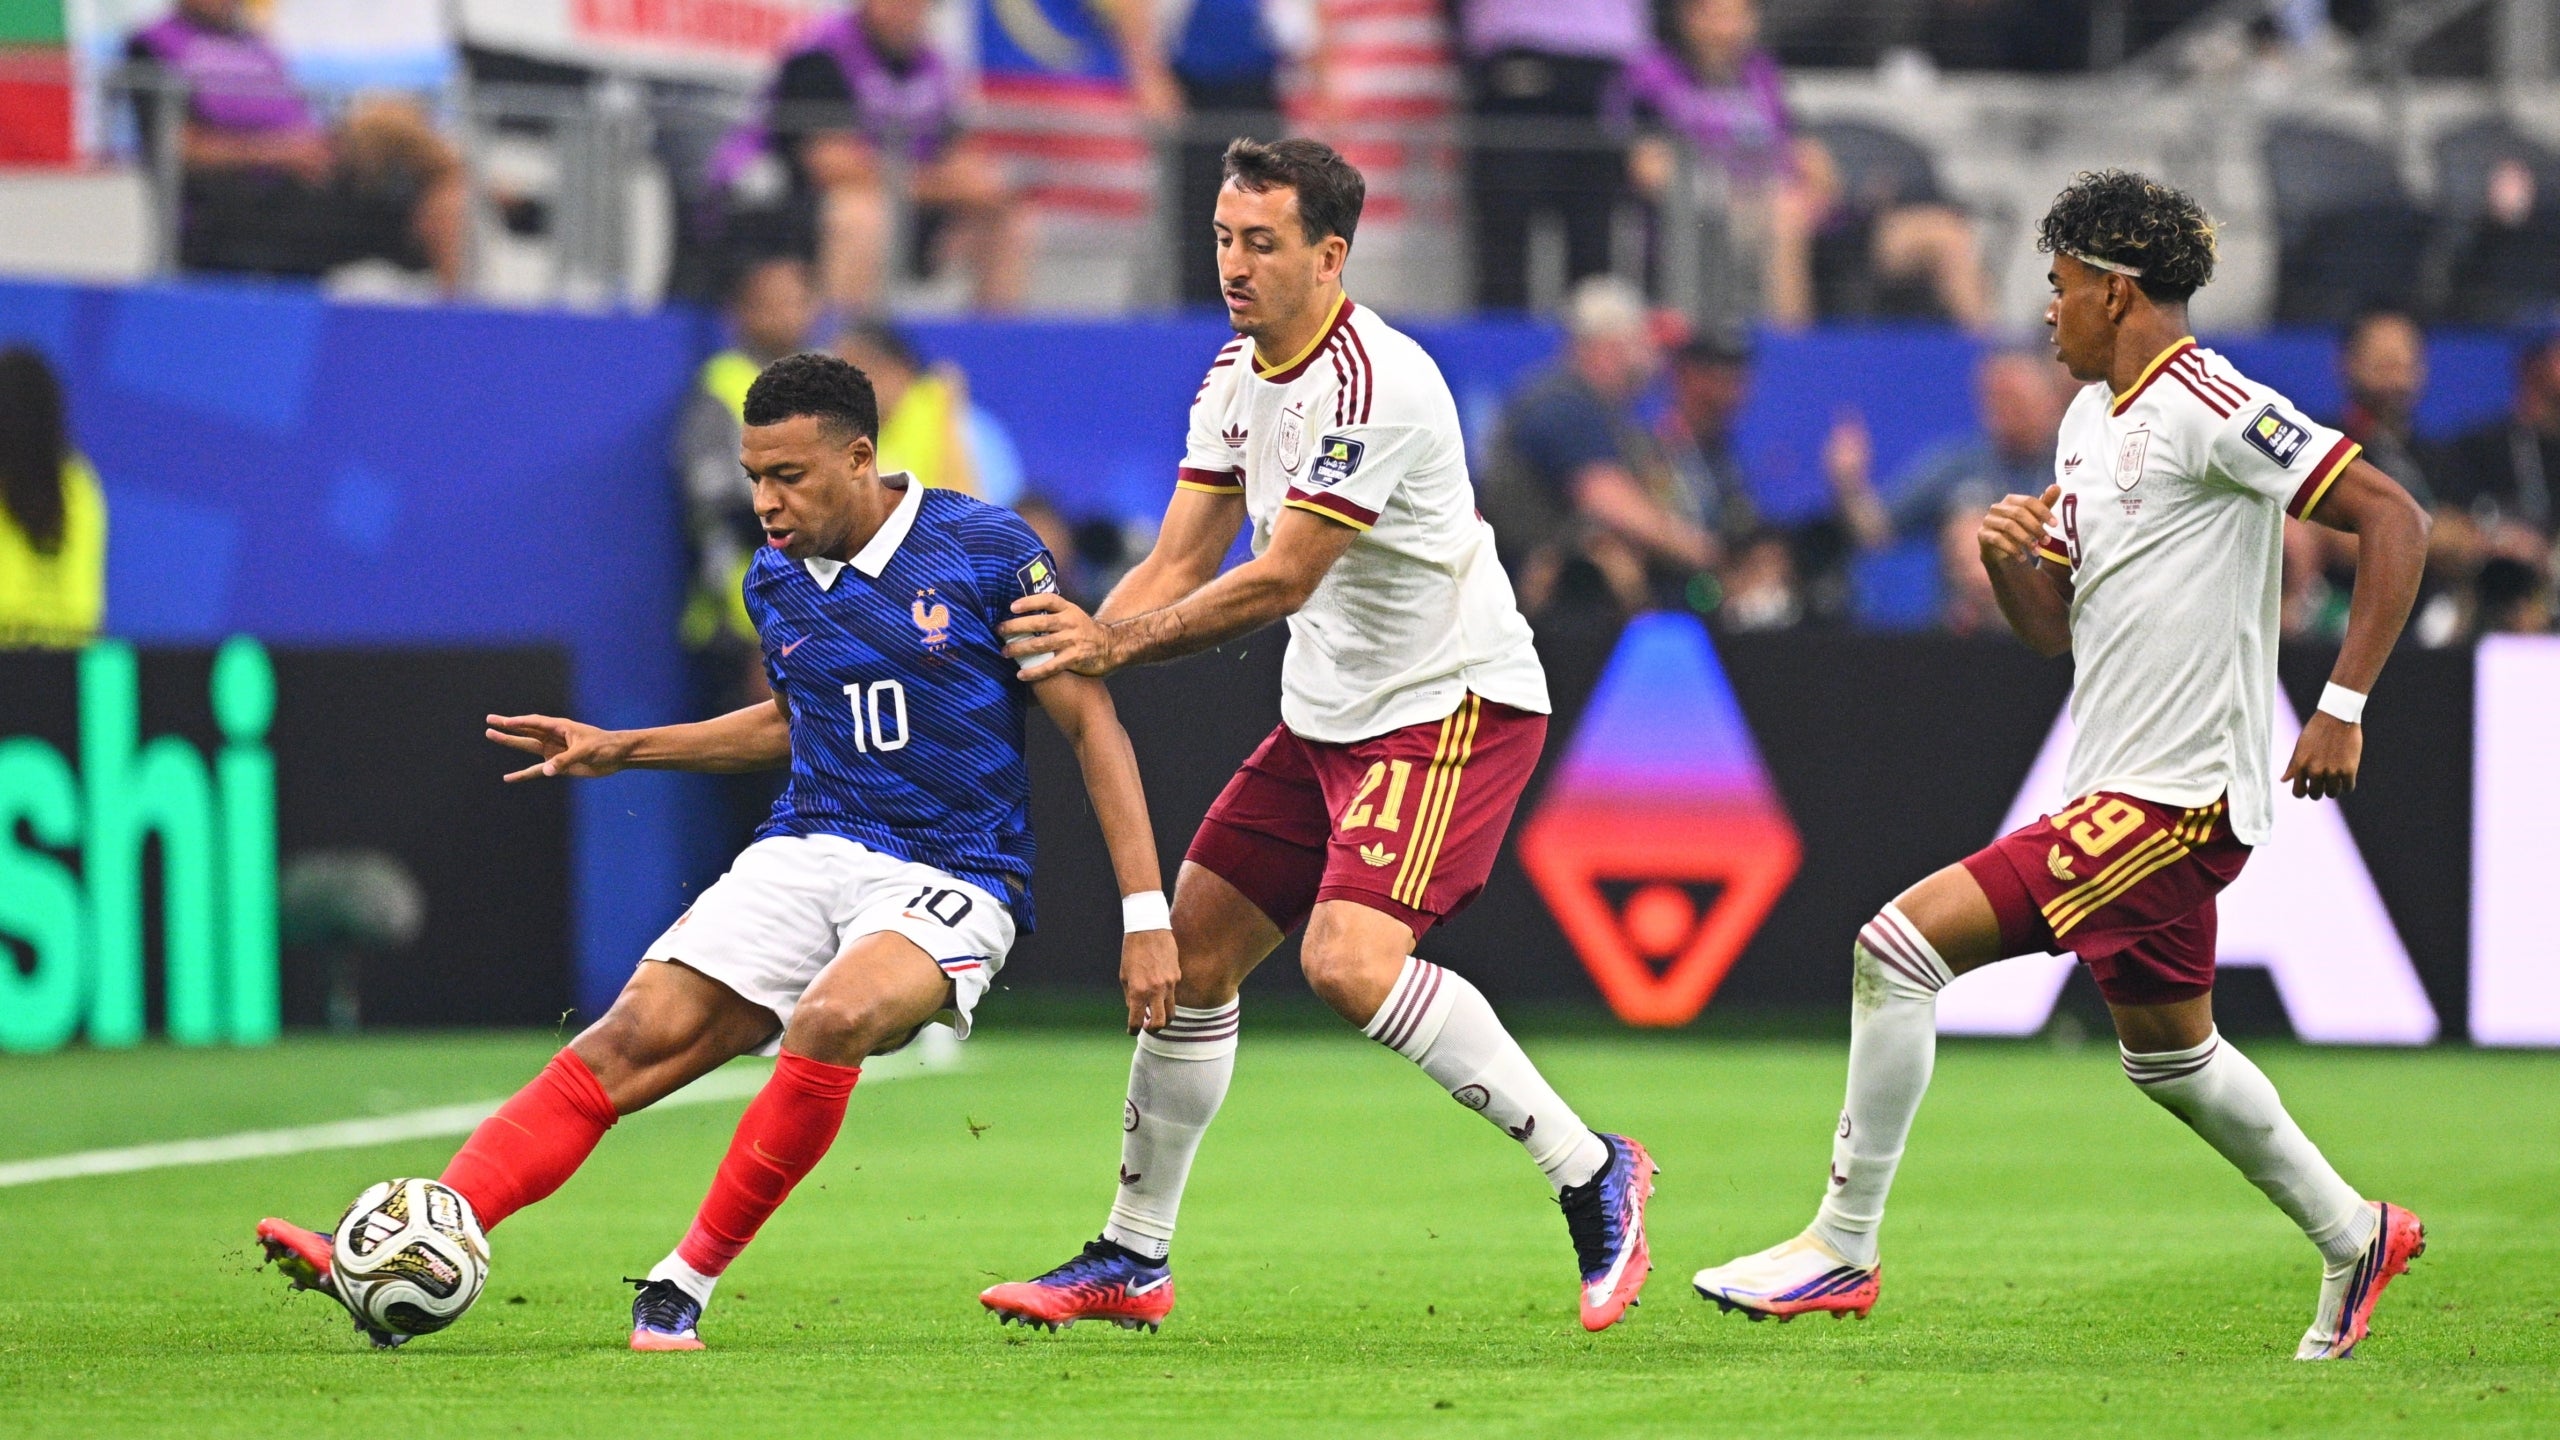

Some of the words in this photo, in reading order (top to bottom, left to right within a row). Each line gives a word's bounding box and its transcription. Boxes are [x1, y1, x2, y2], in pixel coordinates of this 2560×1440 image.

[843, 679, 909, 753] 10
[1340, 759, 1412, 833] 21
[2050, 796, 2145, 857] 19
[0, 634, 281, 1052] shi
[905, 886, 972, 928] 10
